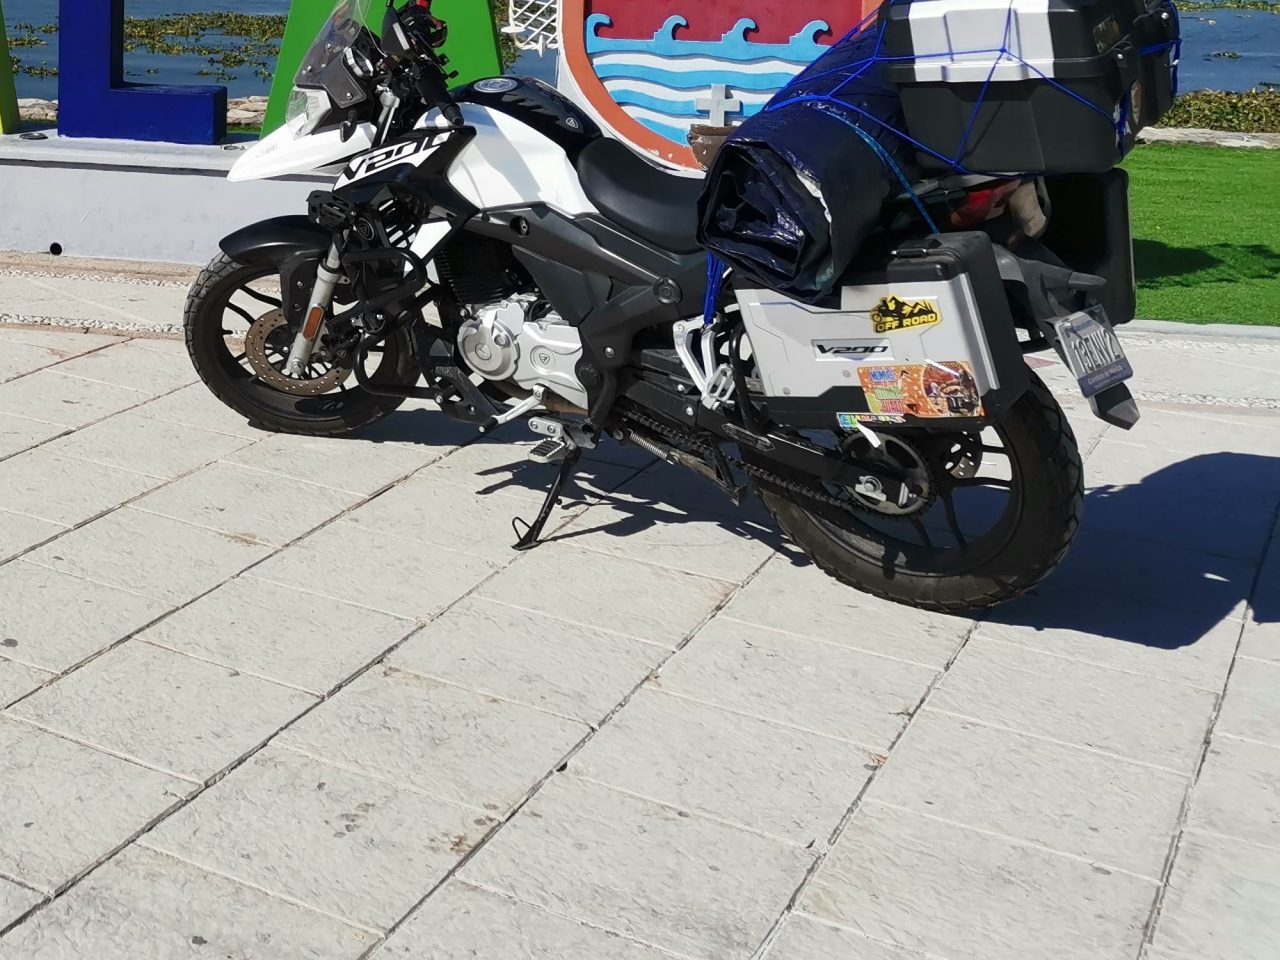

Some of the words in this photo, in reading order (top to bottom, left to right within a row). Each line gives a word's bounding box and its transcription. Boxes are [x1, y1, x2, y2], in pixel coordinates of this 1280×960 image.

[875, 320, 899, 332] OFF
[902, 313, 938, 328] ROAD
[816, 344, 888, 355] V200
